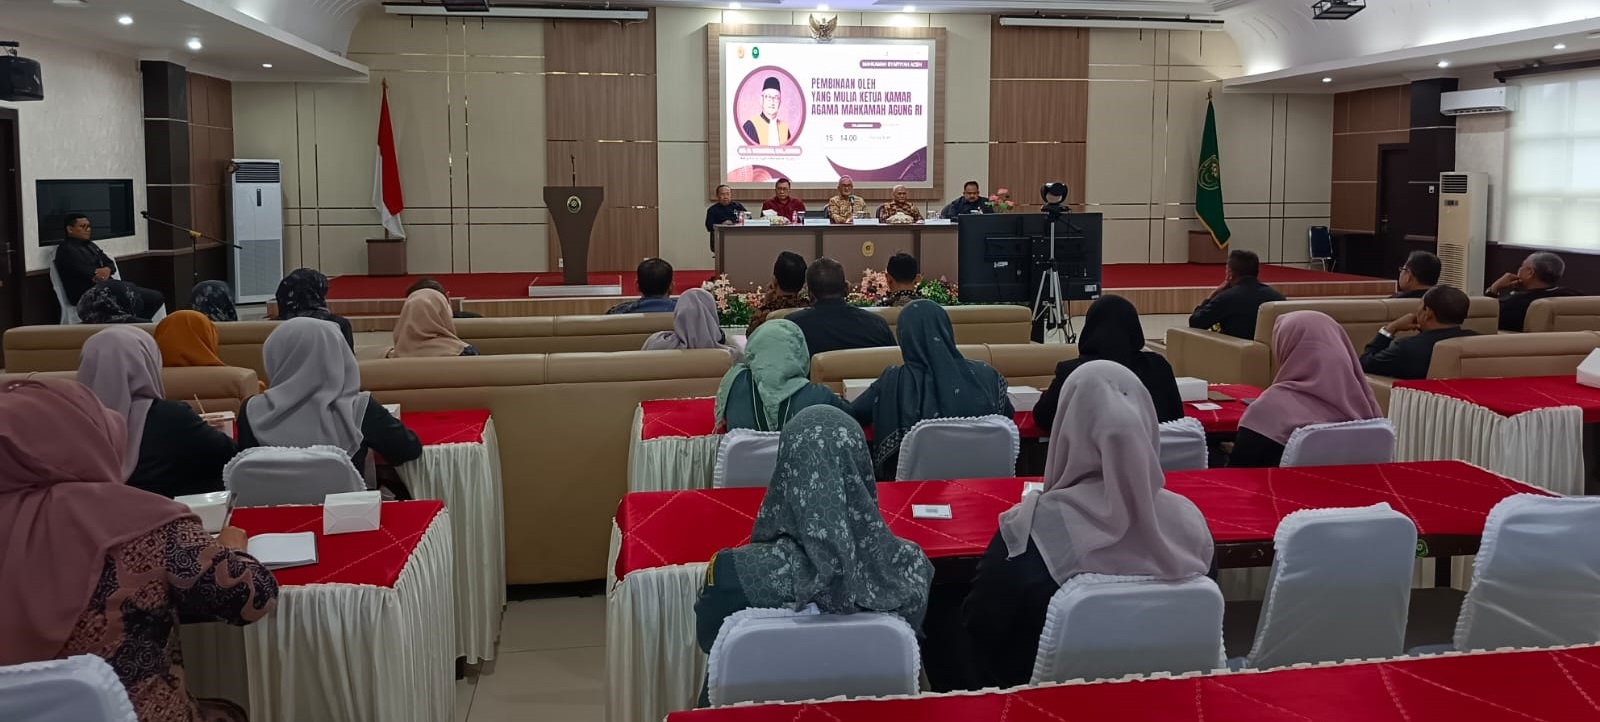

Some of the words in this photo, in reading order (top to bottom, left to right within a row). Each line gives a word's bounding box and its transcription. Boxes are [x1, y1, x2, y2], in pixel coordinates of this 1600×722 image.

[811, 77, 855, 89] PEMBINAAN
[857, 78, 876, 90] OLEH
[811, 91, 831, 102] YANG
[833, 91, 857, 102] MULIA
[859, 91, 882, 102] KETUA
[884, 91, 912, 103] KAMAR
[811, 104, 839, 115] AGAMA
[841, 104, 886, 116] MAHKAMAH
[888, 104, 913, 116] AGUNG
[915, 104, 922, 115] RI
